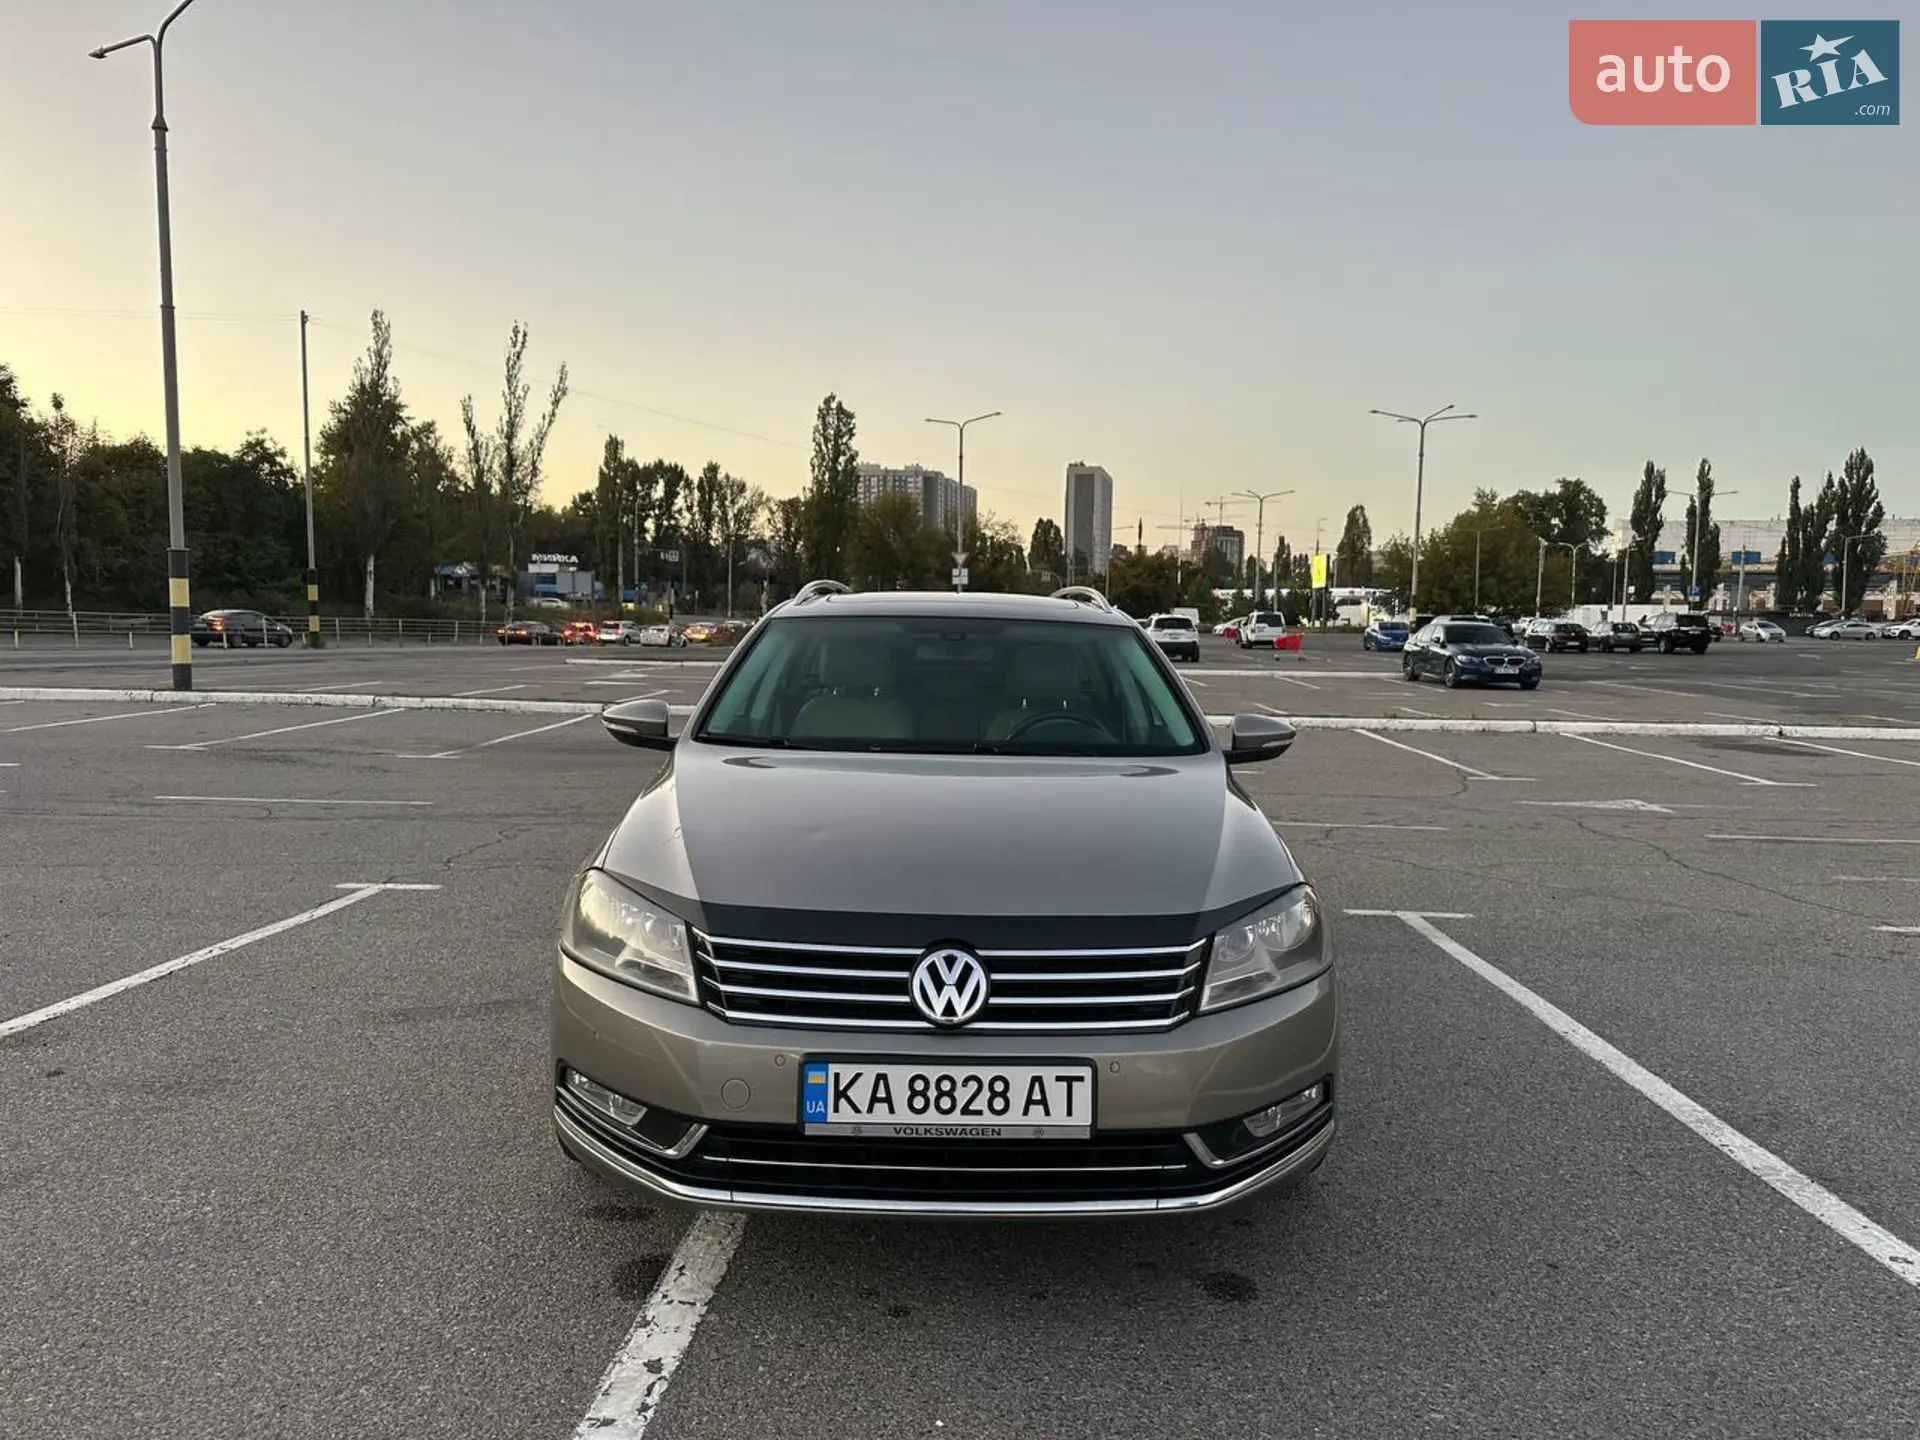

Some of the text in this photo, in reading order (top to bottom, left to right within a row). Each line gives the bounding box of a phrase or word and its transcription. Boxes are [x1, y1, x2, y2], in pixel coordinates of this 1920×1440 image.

[531, 552, 579, 563] МИЙКА
[832, 1072, 1085, 1117] KA 8828 AT
[806, 1101, 825, 1114] UA
[893, 1126, 1002, 1138] VOLKSWAGEN
